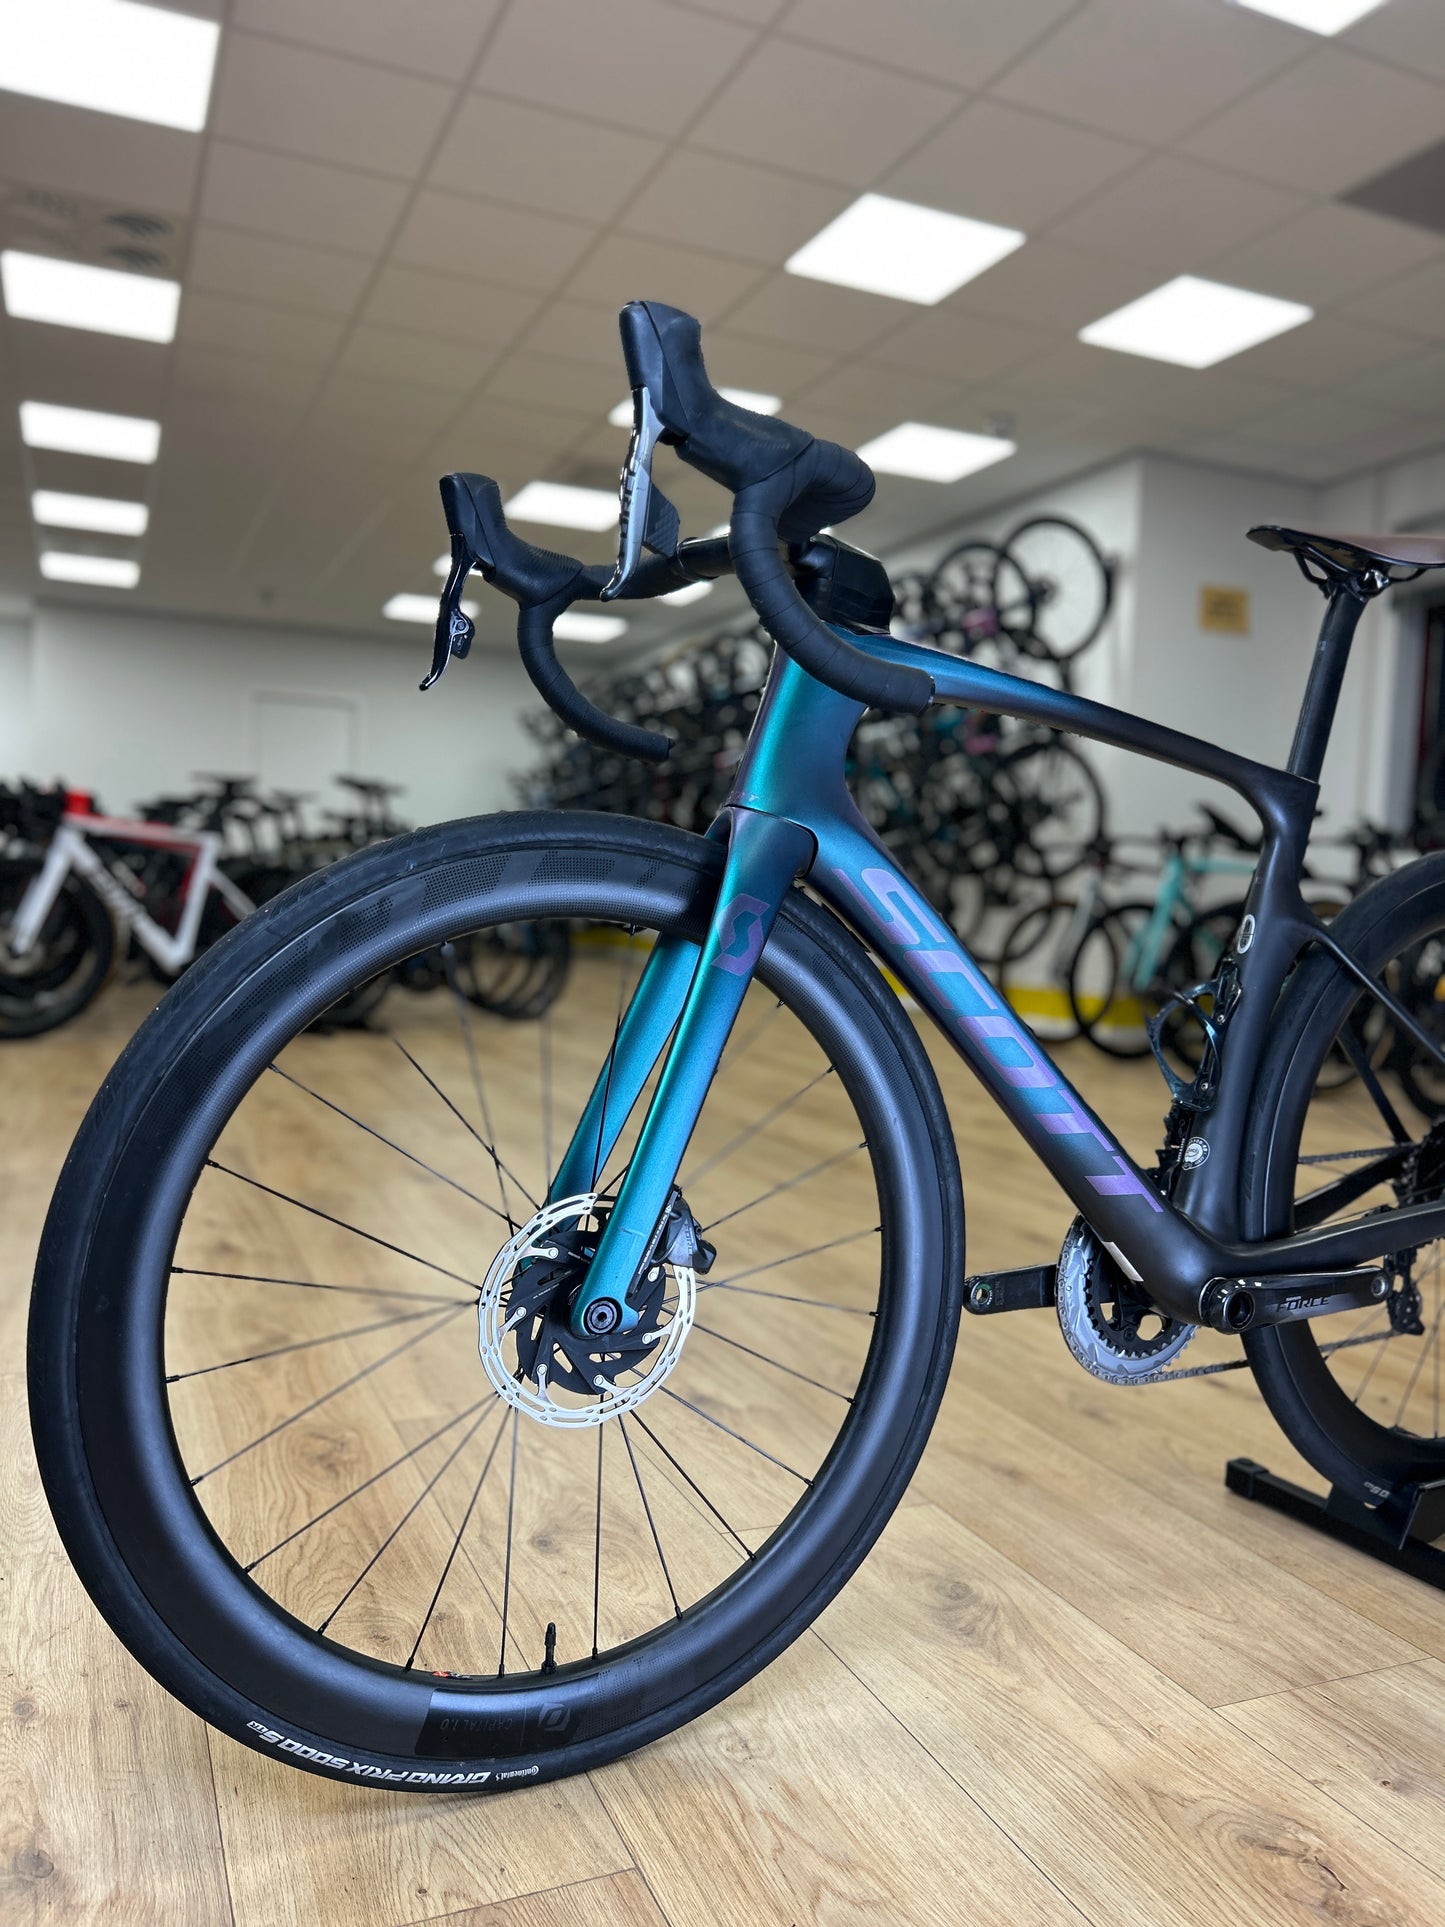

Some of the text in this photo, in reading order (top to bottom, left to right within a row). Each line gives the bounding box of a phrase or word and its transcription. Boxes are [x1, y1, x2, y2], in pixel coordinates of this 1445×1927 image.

[832, 868, 1164, 1213] SCOTT
[1276, 1296, 1330, 1313] FORCE
[440, 1718, 513, 1731] CAPITAL 1.0
[279, 1739, 349, 1769] 5000
[348, 1761, 409, 1781] PRIX
[408, 1771, 491, 1784] GRAND
